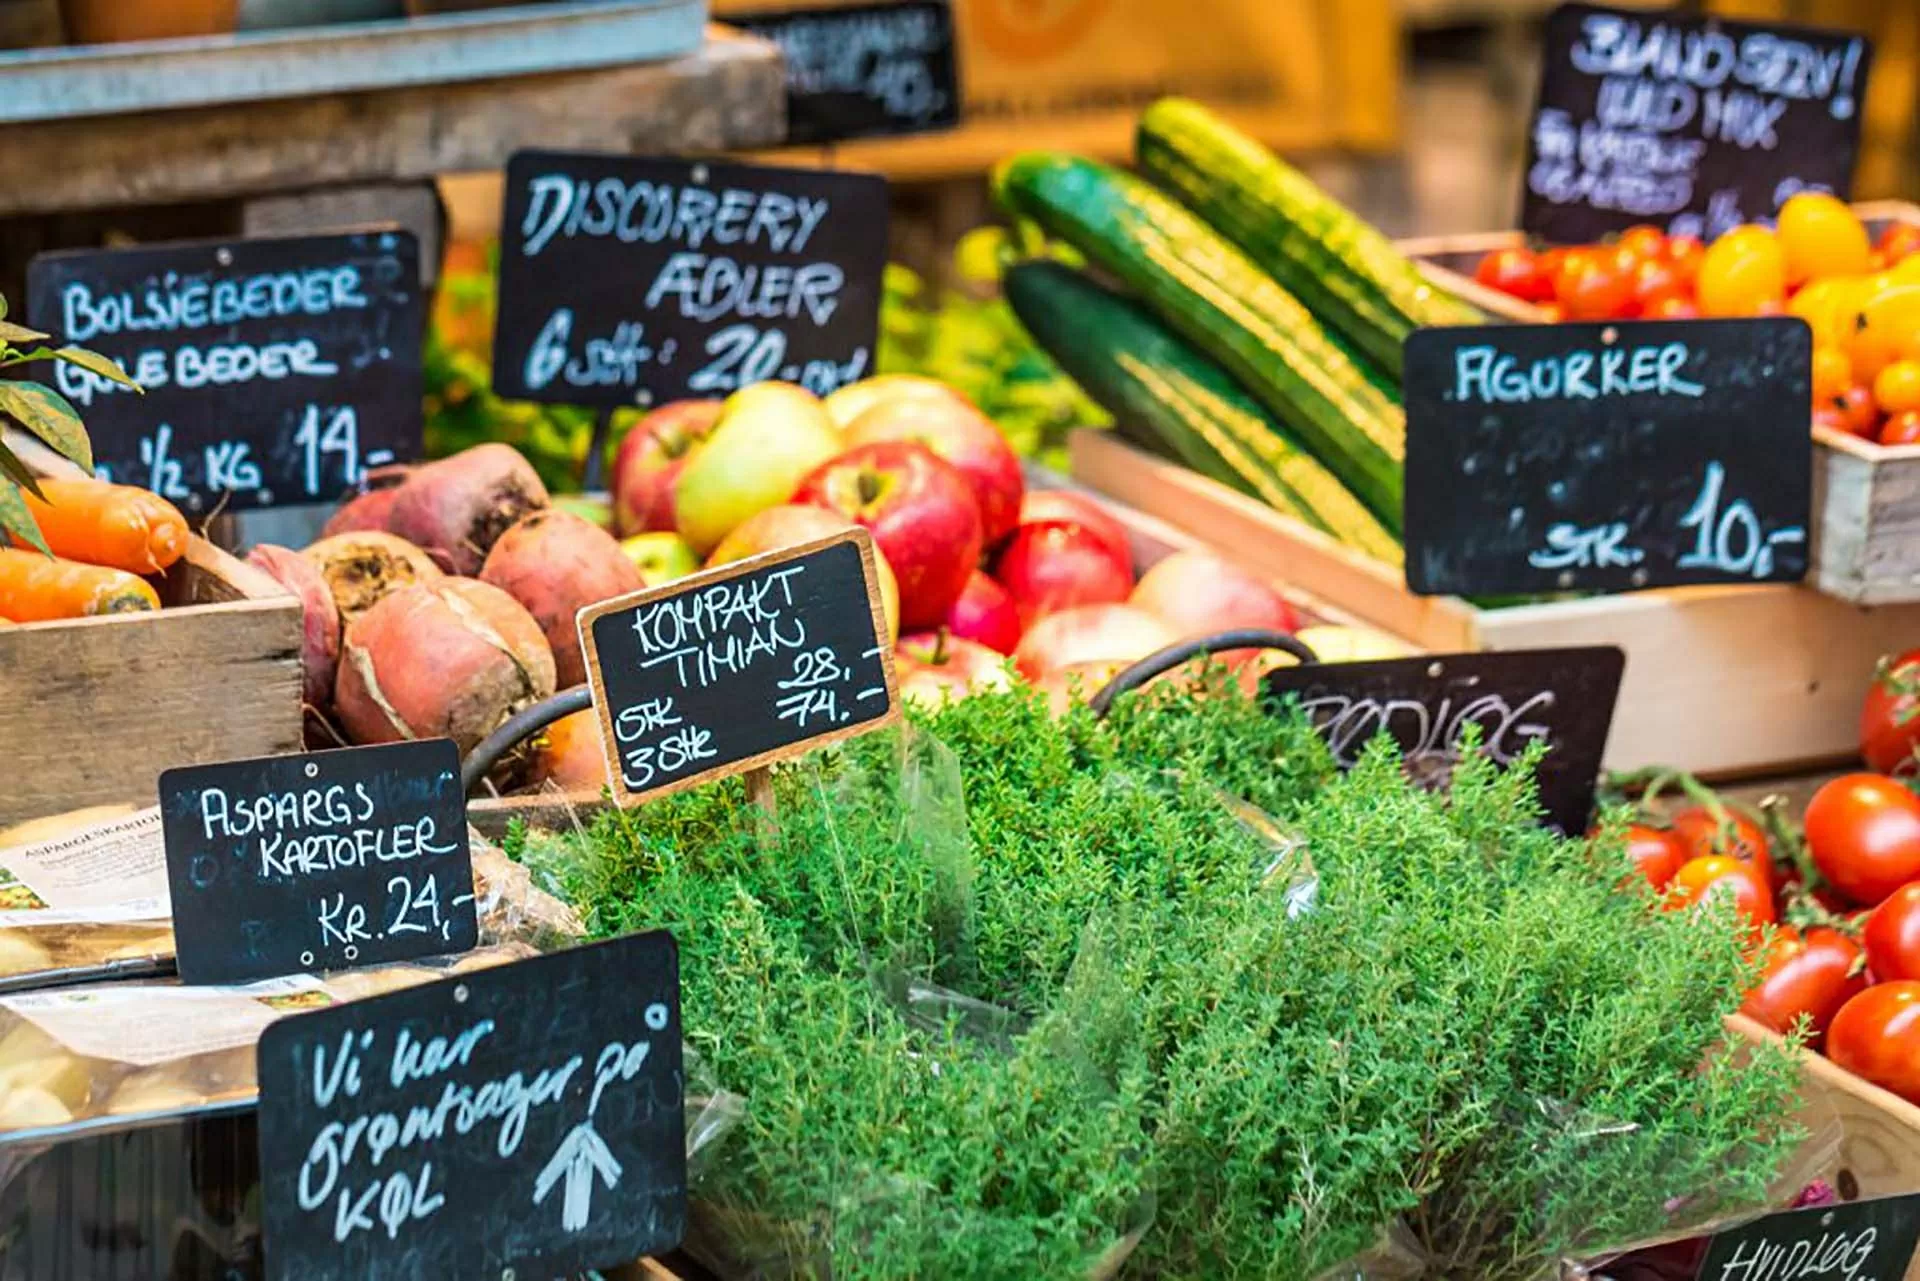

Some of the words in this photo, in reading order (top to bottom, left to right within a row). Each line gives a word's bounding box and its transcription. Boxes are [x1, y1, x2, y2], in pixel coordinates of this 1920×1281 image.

[524, 307, 574, 390] 6
[1455, 341, 1706, 402] AGURKER
[1678, 459, 1807, 579] 10,-
[632, 566, 804, 653] KOMPAKT
[640, 618, 805, 688] TIMIAN
[622, 747, 656, 787] 3
[201, 783, 374, 840] ASPARGS
[258, 816, 458, 878] KARTOFLER
[387, 873, 476, 941] 24,-
[313, 1027, 374, 1108] Vi
[390, 1019, 495, 1088] har
[299, 1055, 583, 1211] grøntsager
[333, 1161, 446, 1243] KØL
